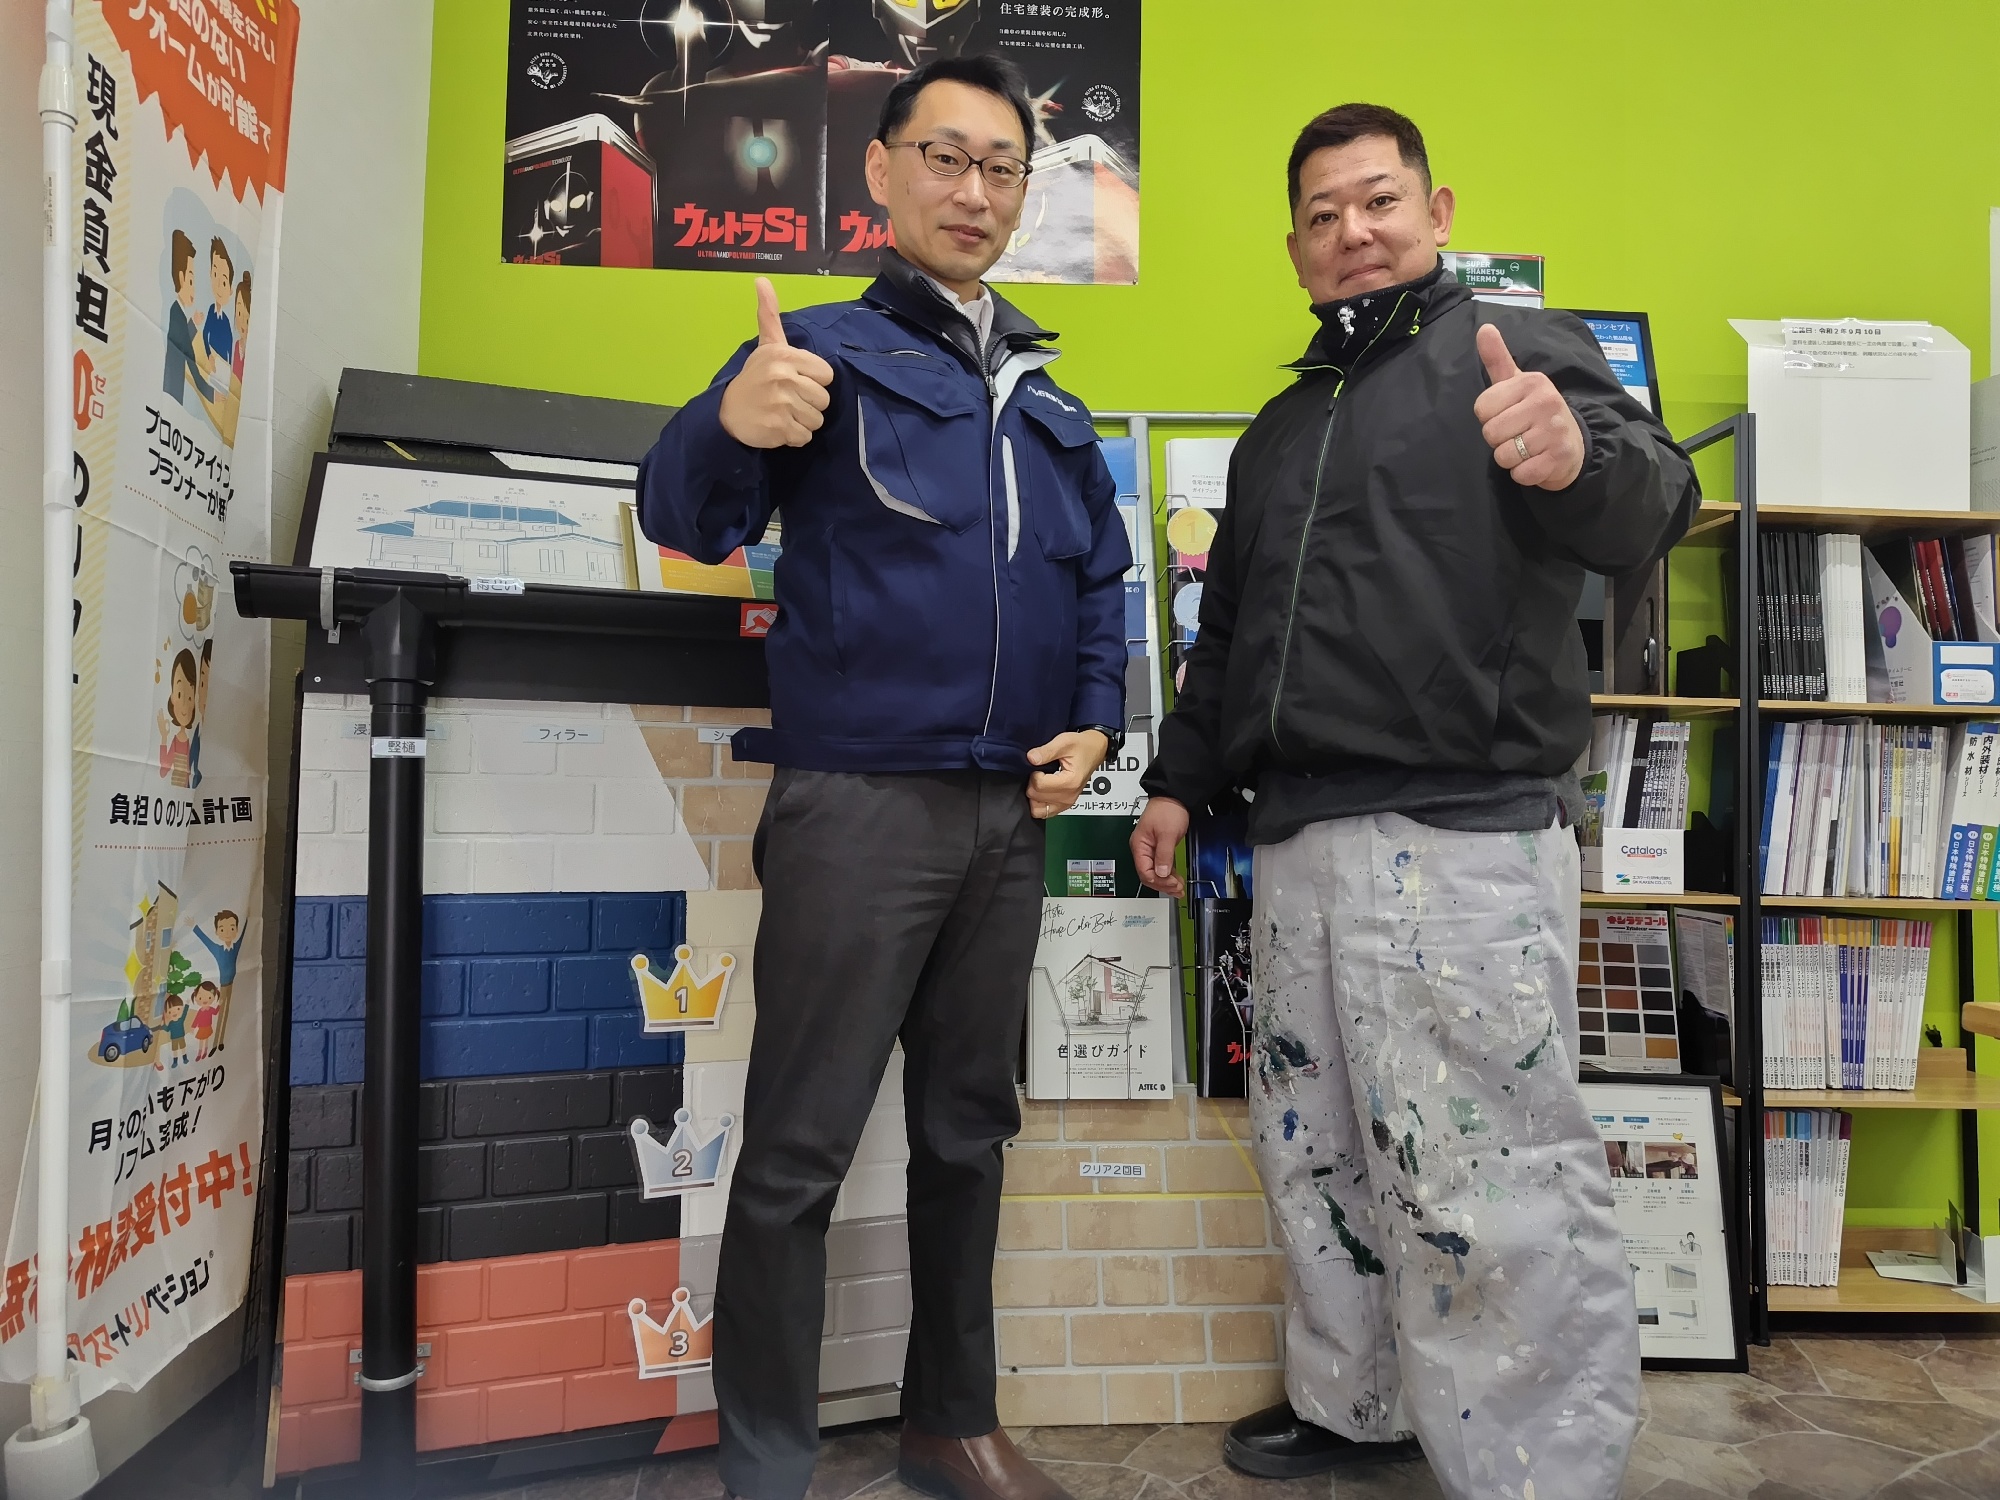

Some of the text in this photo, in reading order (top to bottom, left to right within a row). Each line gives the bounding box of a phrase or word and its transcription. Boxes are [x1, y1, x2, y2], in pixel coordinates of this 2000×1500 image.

[1000, 3, 1111, 19] 住宅塗装の完成形。
[673, 202, 808, 252] ウルトラSi
[1466, 260, 1491, 268] SUPER
[1465, 268, 1506, 276] SHANETSU
[1465, 275, 1497, 283] THERMO
[538, 728, 589, 741] フィラー
[1621, 845, 1668, 857] Catalogs
[1089, 910, 1118, 934] Book
[674, 985, 689, 1014] 1
[1057, 1043, 1148, 1059] 色選びガイド
[1138, 1083, 1158, 1092] ASTEC
[671, 1148, 693, 1178] 2
[1082, 1163, 1143, 1176] クリア2回目
[669, 1329, 690, 1357] 3
